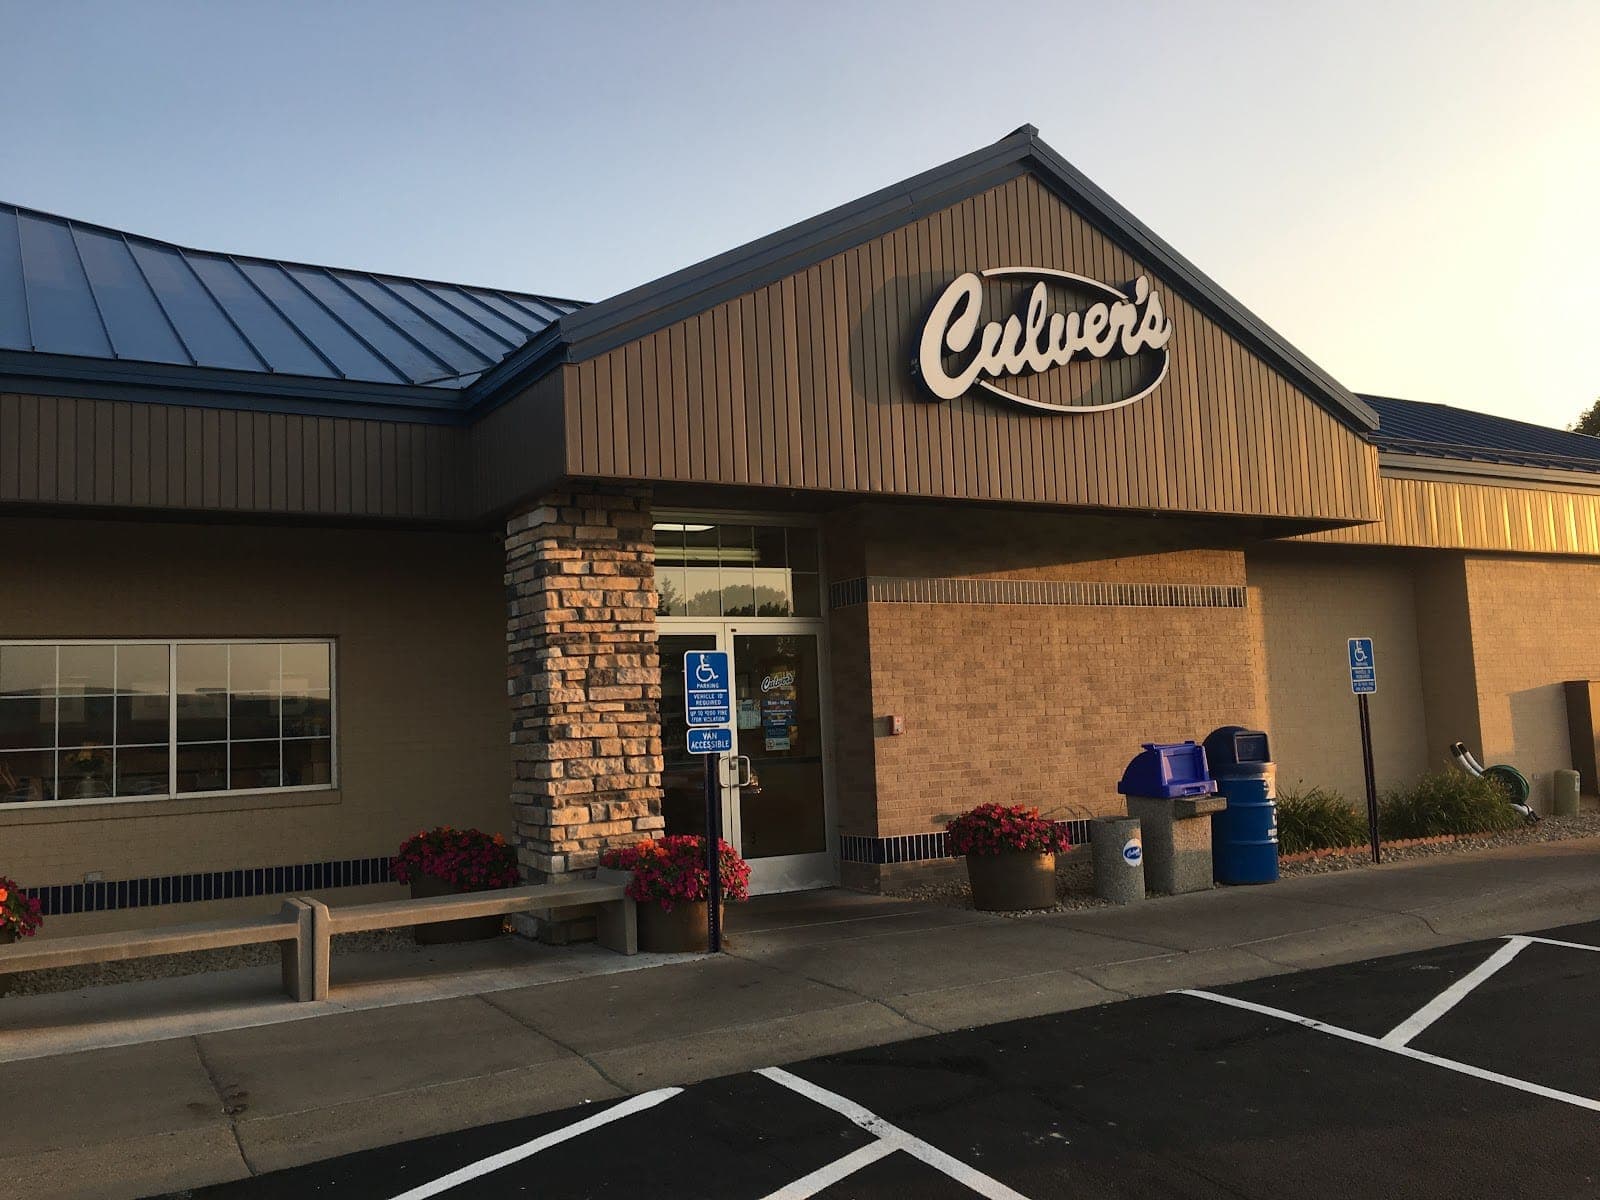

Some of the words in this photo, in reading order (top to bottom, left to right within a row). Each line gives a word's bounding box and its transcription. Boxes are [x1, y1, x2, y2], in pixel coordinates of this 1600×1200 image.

[920, 272, 1173, 400] Culver's
[702, 732, 718, 740] VAN
[690, 740, 730, 750] ACCESSIBLE
